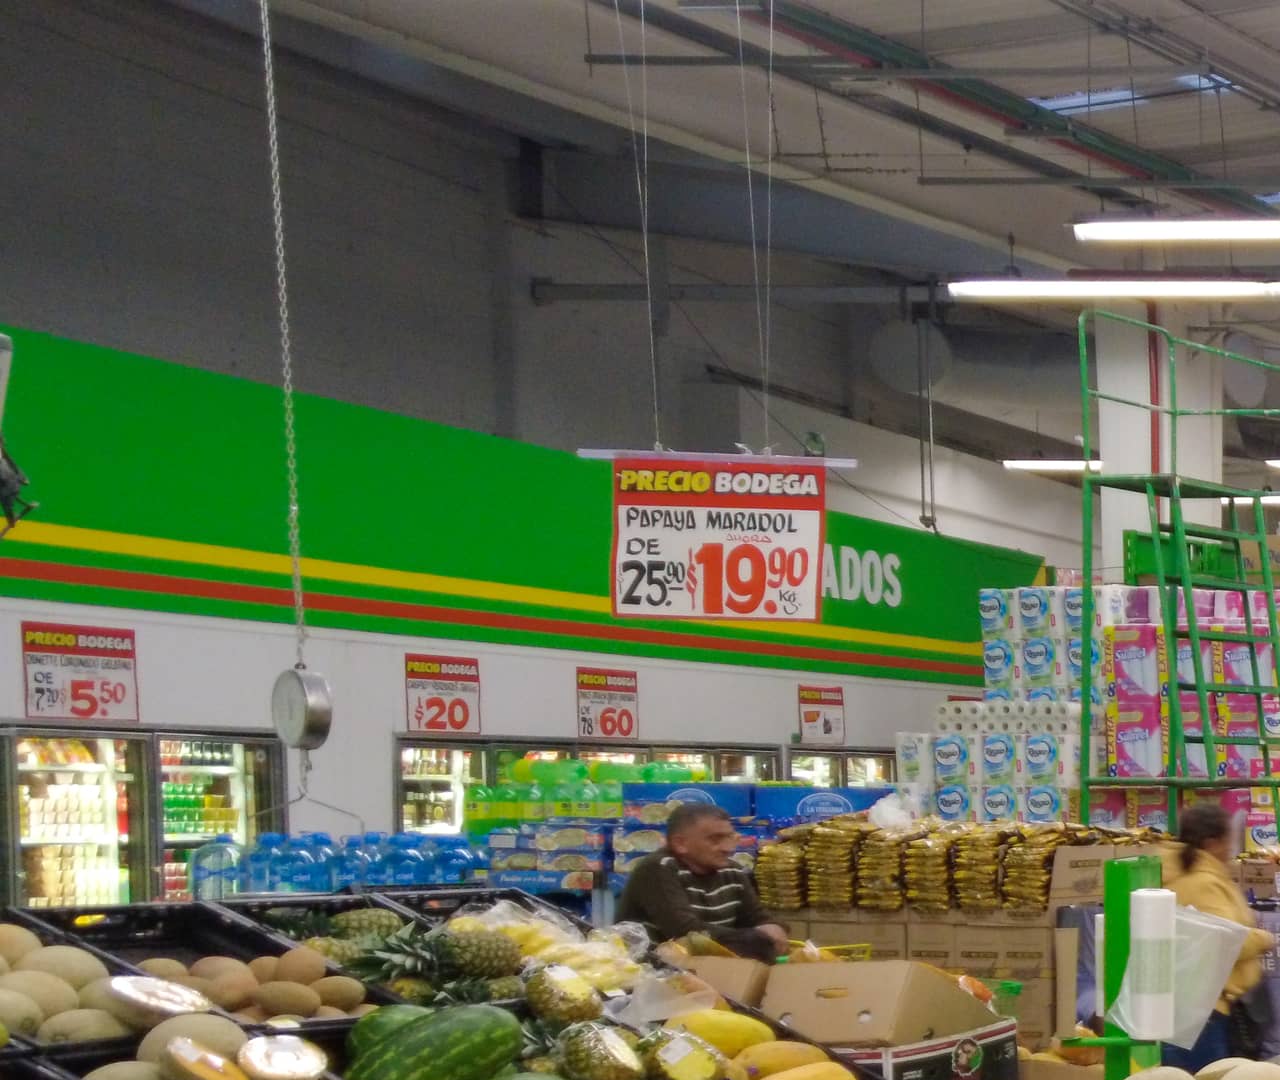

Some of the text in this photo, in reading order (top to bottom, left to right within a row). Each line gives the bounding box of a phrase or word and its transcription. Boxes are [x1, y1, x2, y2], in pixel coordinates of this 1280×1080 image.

[619, 470, 819, 496] PRECIO BODEGA
[626, 507, 798, 533] PAPAYA MARADOL
[626, 538, 661, 555] DE
[24, 631, 132, 650] PRECIO BODEGA
[414, 696, 470, 730] $20
